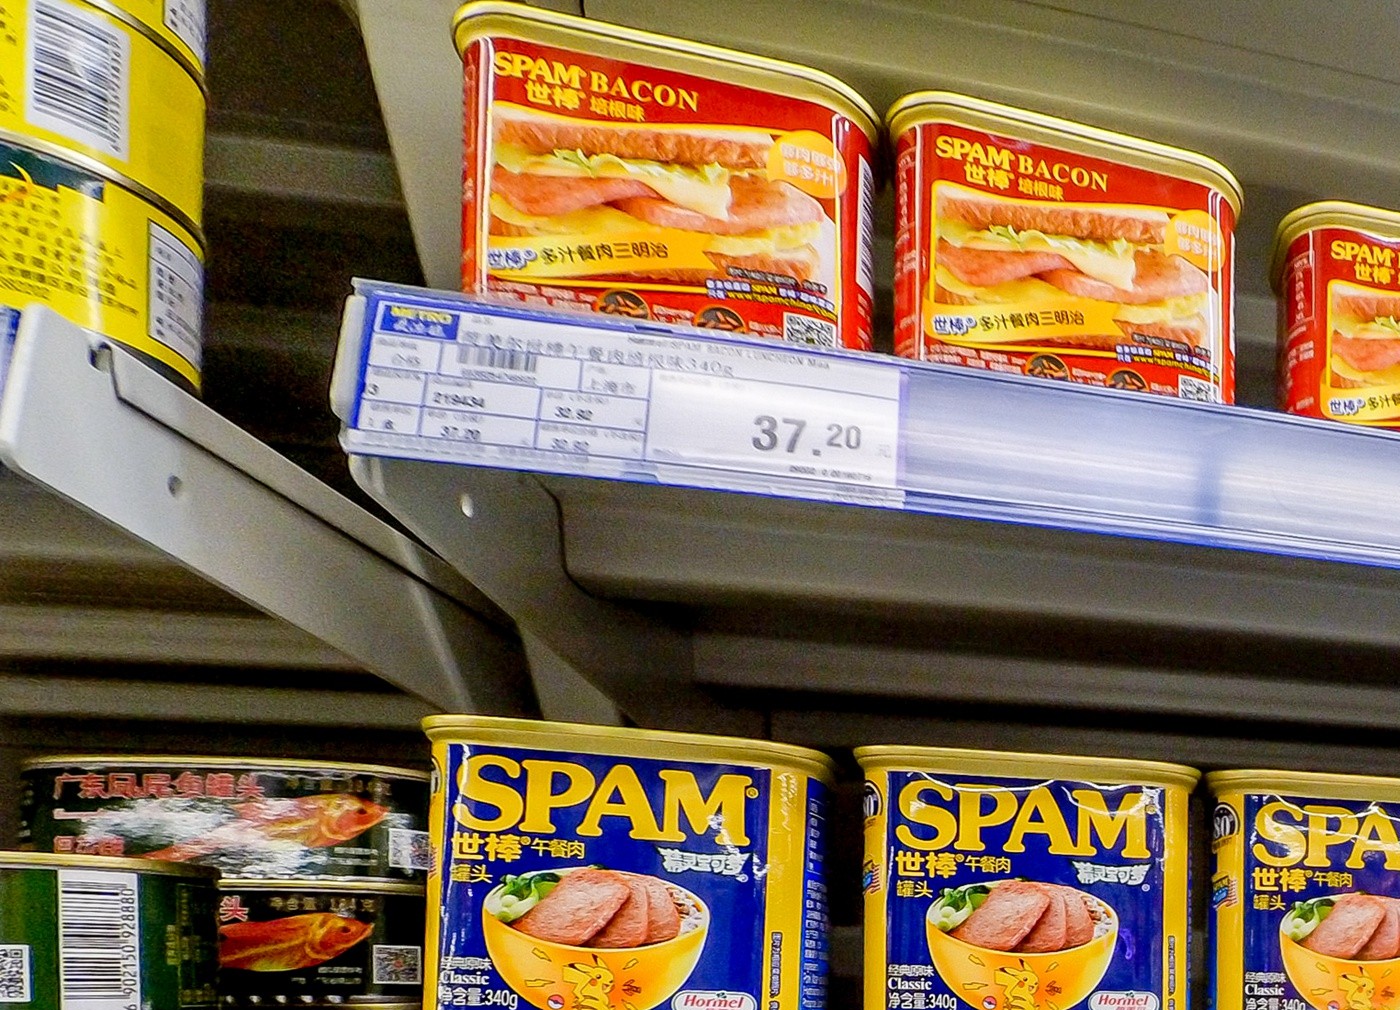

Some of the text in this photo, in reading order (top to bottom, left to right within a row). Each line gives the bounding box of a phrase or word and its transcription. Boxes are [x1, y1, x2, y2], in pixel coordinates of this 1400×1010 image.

[494, 51, 699, 113] SPAM BACON
[936, 136, 1109, 193] SPAM BACON
[964, 162, 1011, 190] 世棒
[541, 241, 669, 265] 多汁餐肉三明治
[1331, 240, 1392, 267] SPAM
[1354, 262, 1392, 285] 世棒
[981, 310, 1085, 330] 多汁餐肉三明治
[752, 414, 862, 457] 37.20
[451, 754, 753, 846] SPAM
[895, 779, 1151, 858] SPAM
[451, 832, 585, 862] 世棒 午餐肉
[450, 863, 493, 884] 罐头
[895, 851, 1011, 878] 世棒 午餐肉
[896, 880, 933, 899] 罐头
[1252, 868, 1352, 892] 世棒 午餐肉
[120, 888, 135, 938] 928880
[220, 895, 249, 922] 头
[1253, 895, 1286, 911] 罐头
[121, 945, 137, 996] 902150
[440, 971, 489, 986] Classic
[888, 978, 933, 991] Classic
[1245, 984, 1285, 996] Classic
[683, 995, 743, 1009] Hormel
[1098, 994, 1149, 1007] Hormel
